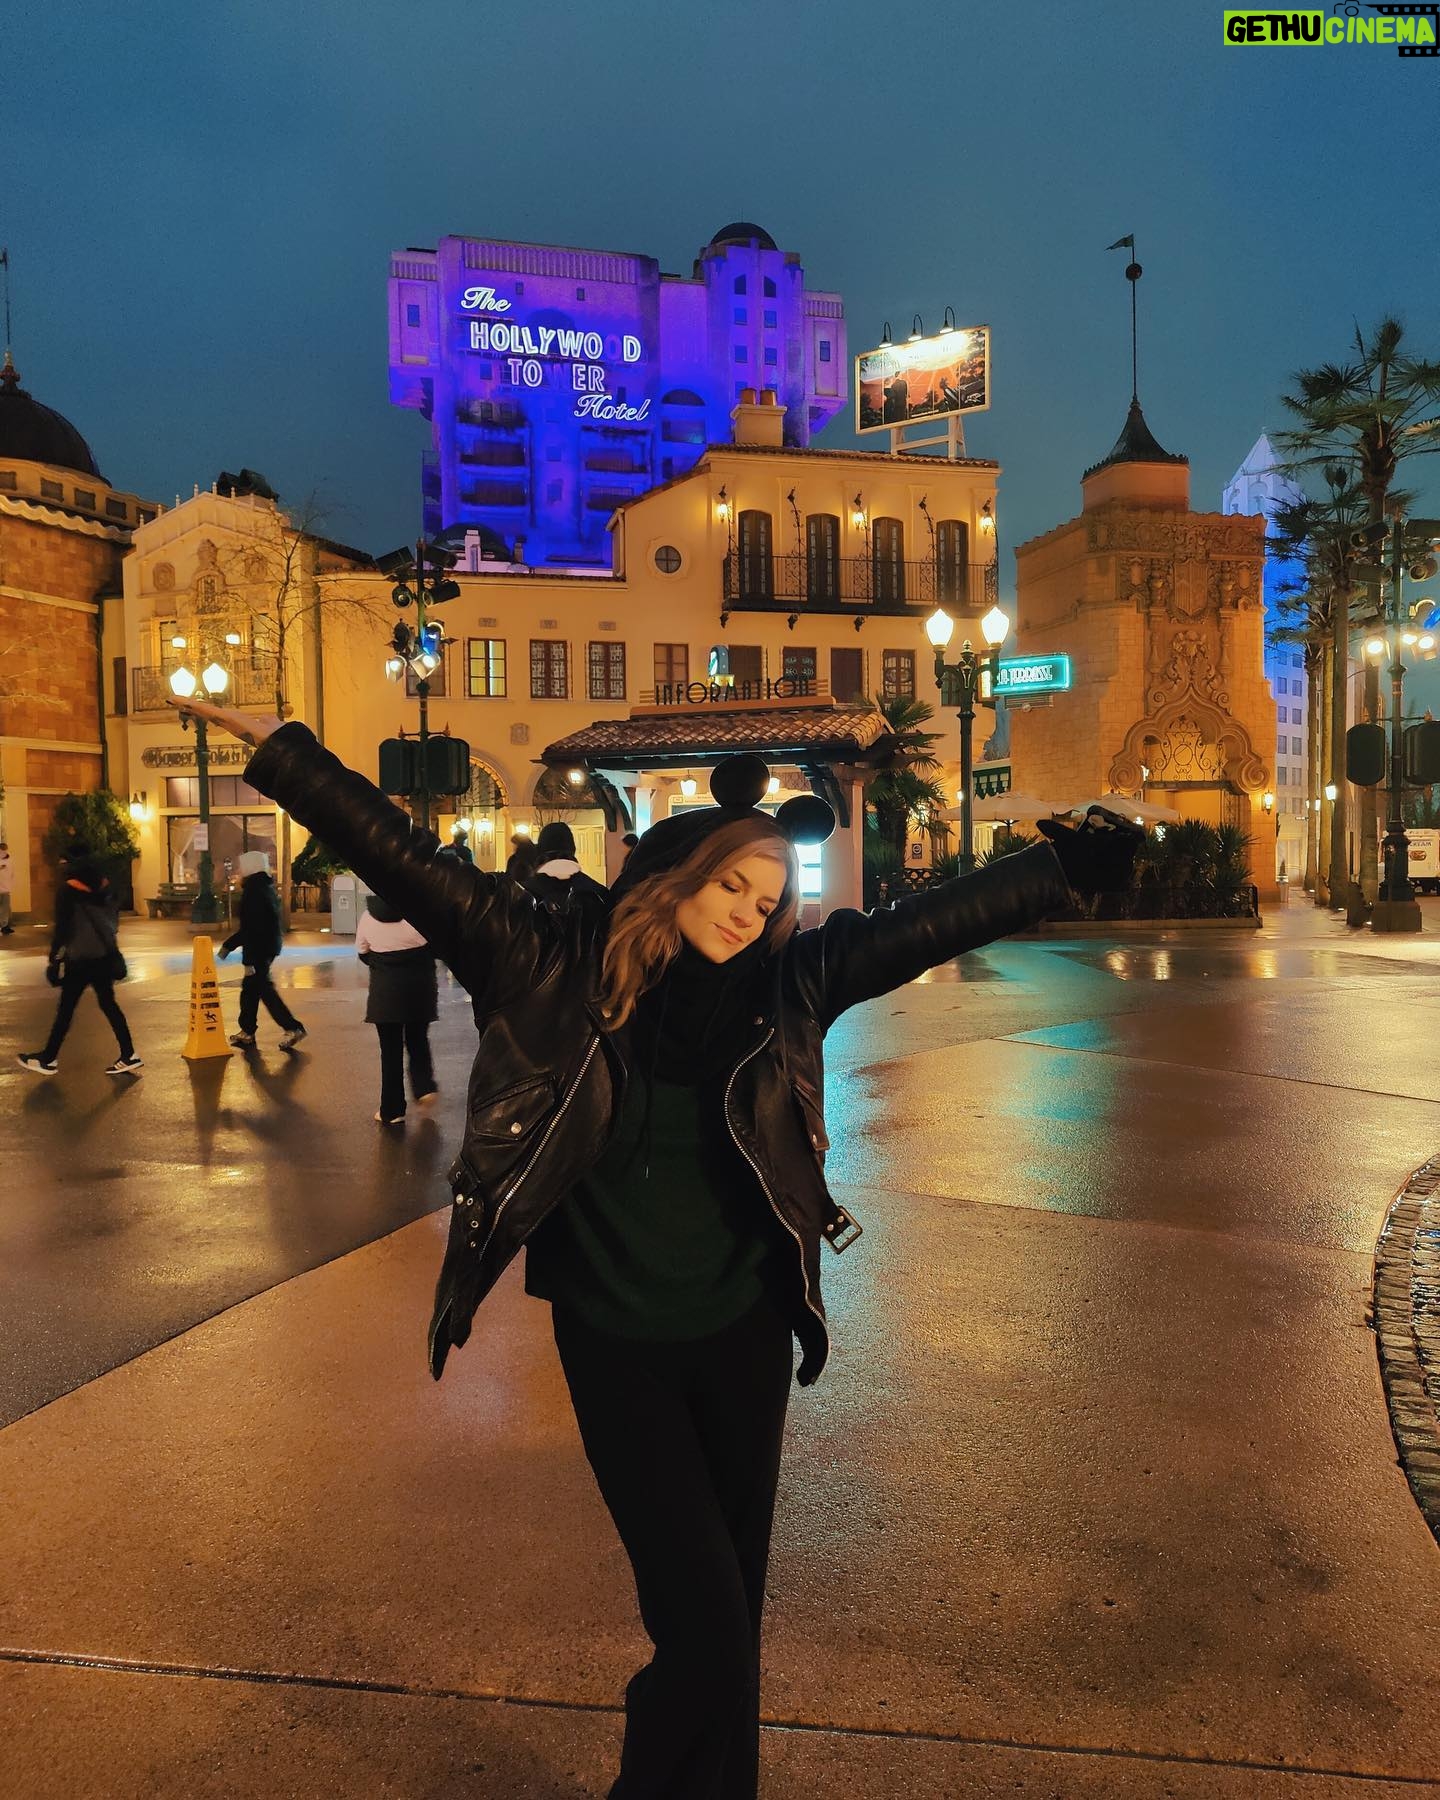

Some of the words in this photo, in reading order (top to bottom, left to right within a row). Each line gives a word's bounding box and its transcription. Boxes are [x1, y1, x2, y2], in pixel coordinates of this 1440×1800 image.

[460, 286, 512, 312] The
[574, 394, 651, 421] Hotel
[655, 676, 810, 706] INFORMATION
